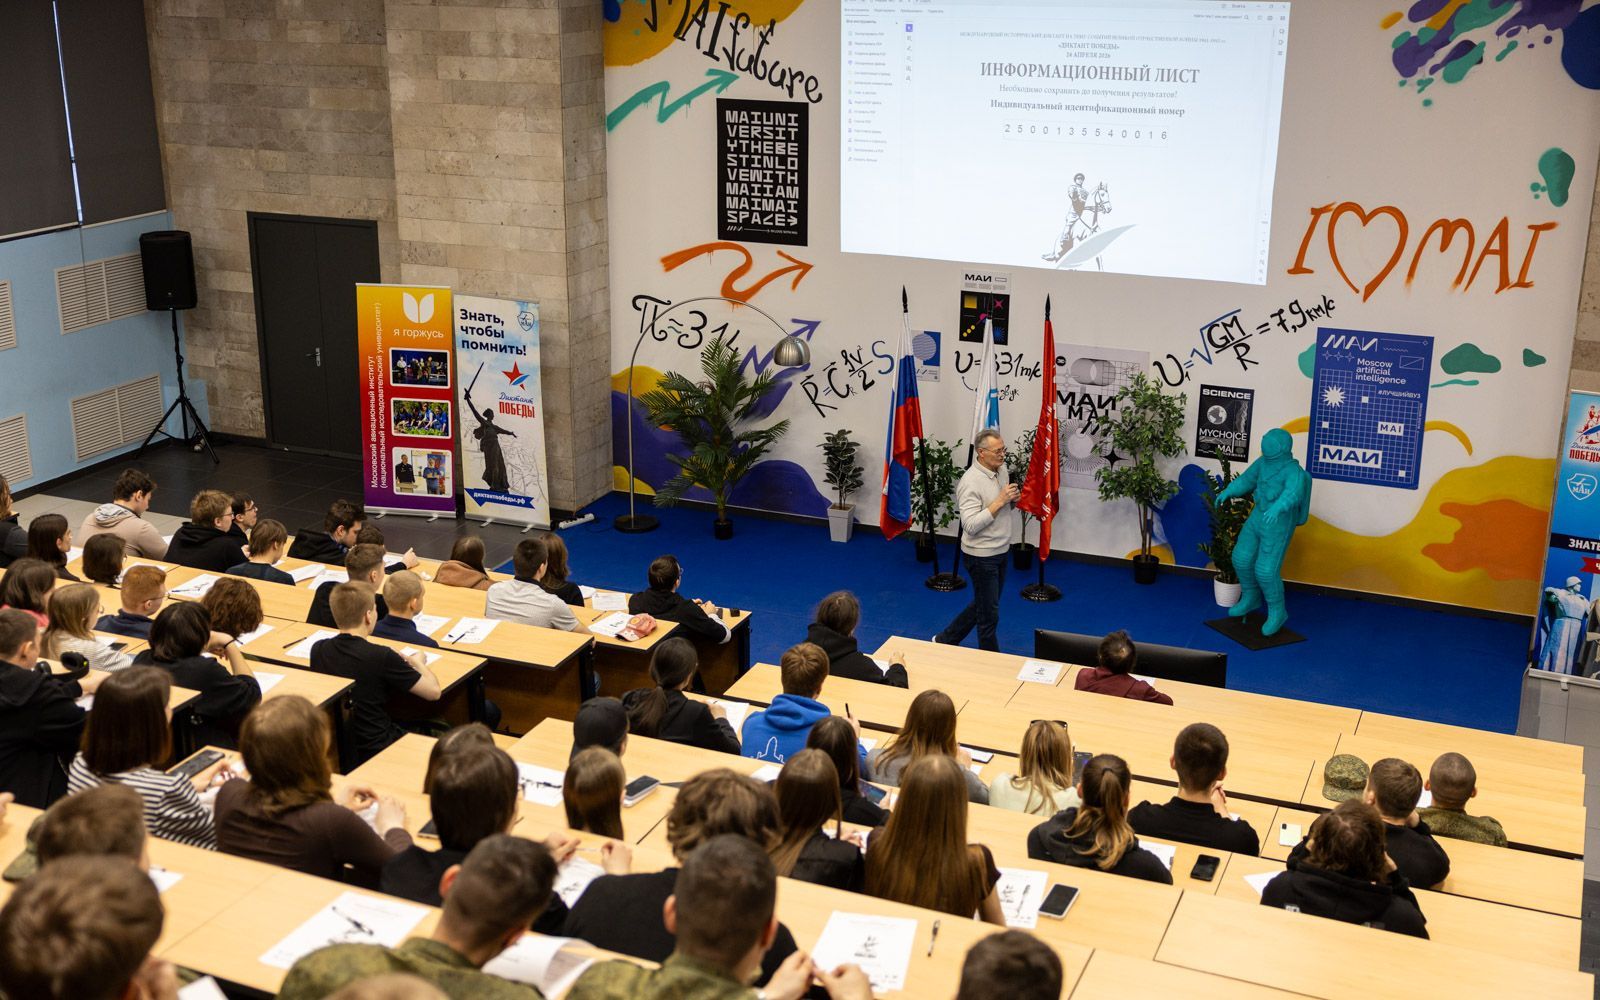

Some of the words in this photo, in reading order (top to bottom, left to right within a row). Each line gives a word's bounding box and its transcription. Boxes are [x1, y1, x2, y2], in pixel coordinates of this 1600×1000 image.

[980, 62, 1151, 82] ИНФОРМАЦИОННЫЙ
[1154, 68, 1200, 84] ЛИСТ
[1000, 84, 1042, 94] Необходимо
[1044, 87, 1080, 96] сохранить
[1081, 88, 1090, 96] до
[1092, 89, 1130, 98] получения
[990, 100, 1063, 111] Индивидуальный
[1064, 103, 1156, 114] идентификационный
[1158, 106, 1186, 117] номер
[726, 110, 798, 126] MAIUNI
[726, 124, 798, 140] VERSIT
[726, 139, 798, 155] YTHEBE
[726, 154, 798, 170] STINLO
[726, 168, 798, 184] VEWITH
[726, 182, 800, 199] MAIIAM
[726, 196, 798, 214] MAIMAI
[1404, 216, 1560, 296] MAI
[460, 308, 505, 326] Знать,
[375, 302, 384, 354] университет)
[394, 328, 400, 336] я
[402, 329, 444, 340] горжусь
[460, 326, 504, 339] чтобы
[461, 340, 526, 356] помнить!
[1356, 358, 1394, 368] Moscow
[1356, 366, 1390, 376] artificial
[368, 356, 376, 390] институт
[1355, 374, 1406, 384] intelligence
[376, 356, 386, 430] исследовательский
[1202, 388, 1252, 400] SCIENCE
[368, 391, 377, 442] авиационный
[498, 402, 535, 418] ПОБЕДЫ
[1380, 424, 1402, 433] MAI
[378, 431, 388, 489] (национальный
[1322, 447, 1379, 465] МАИ
[370, 443, 378, 488] Московский
